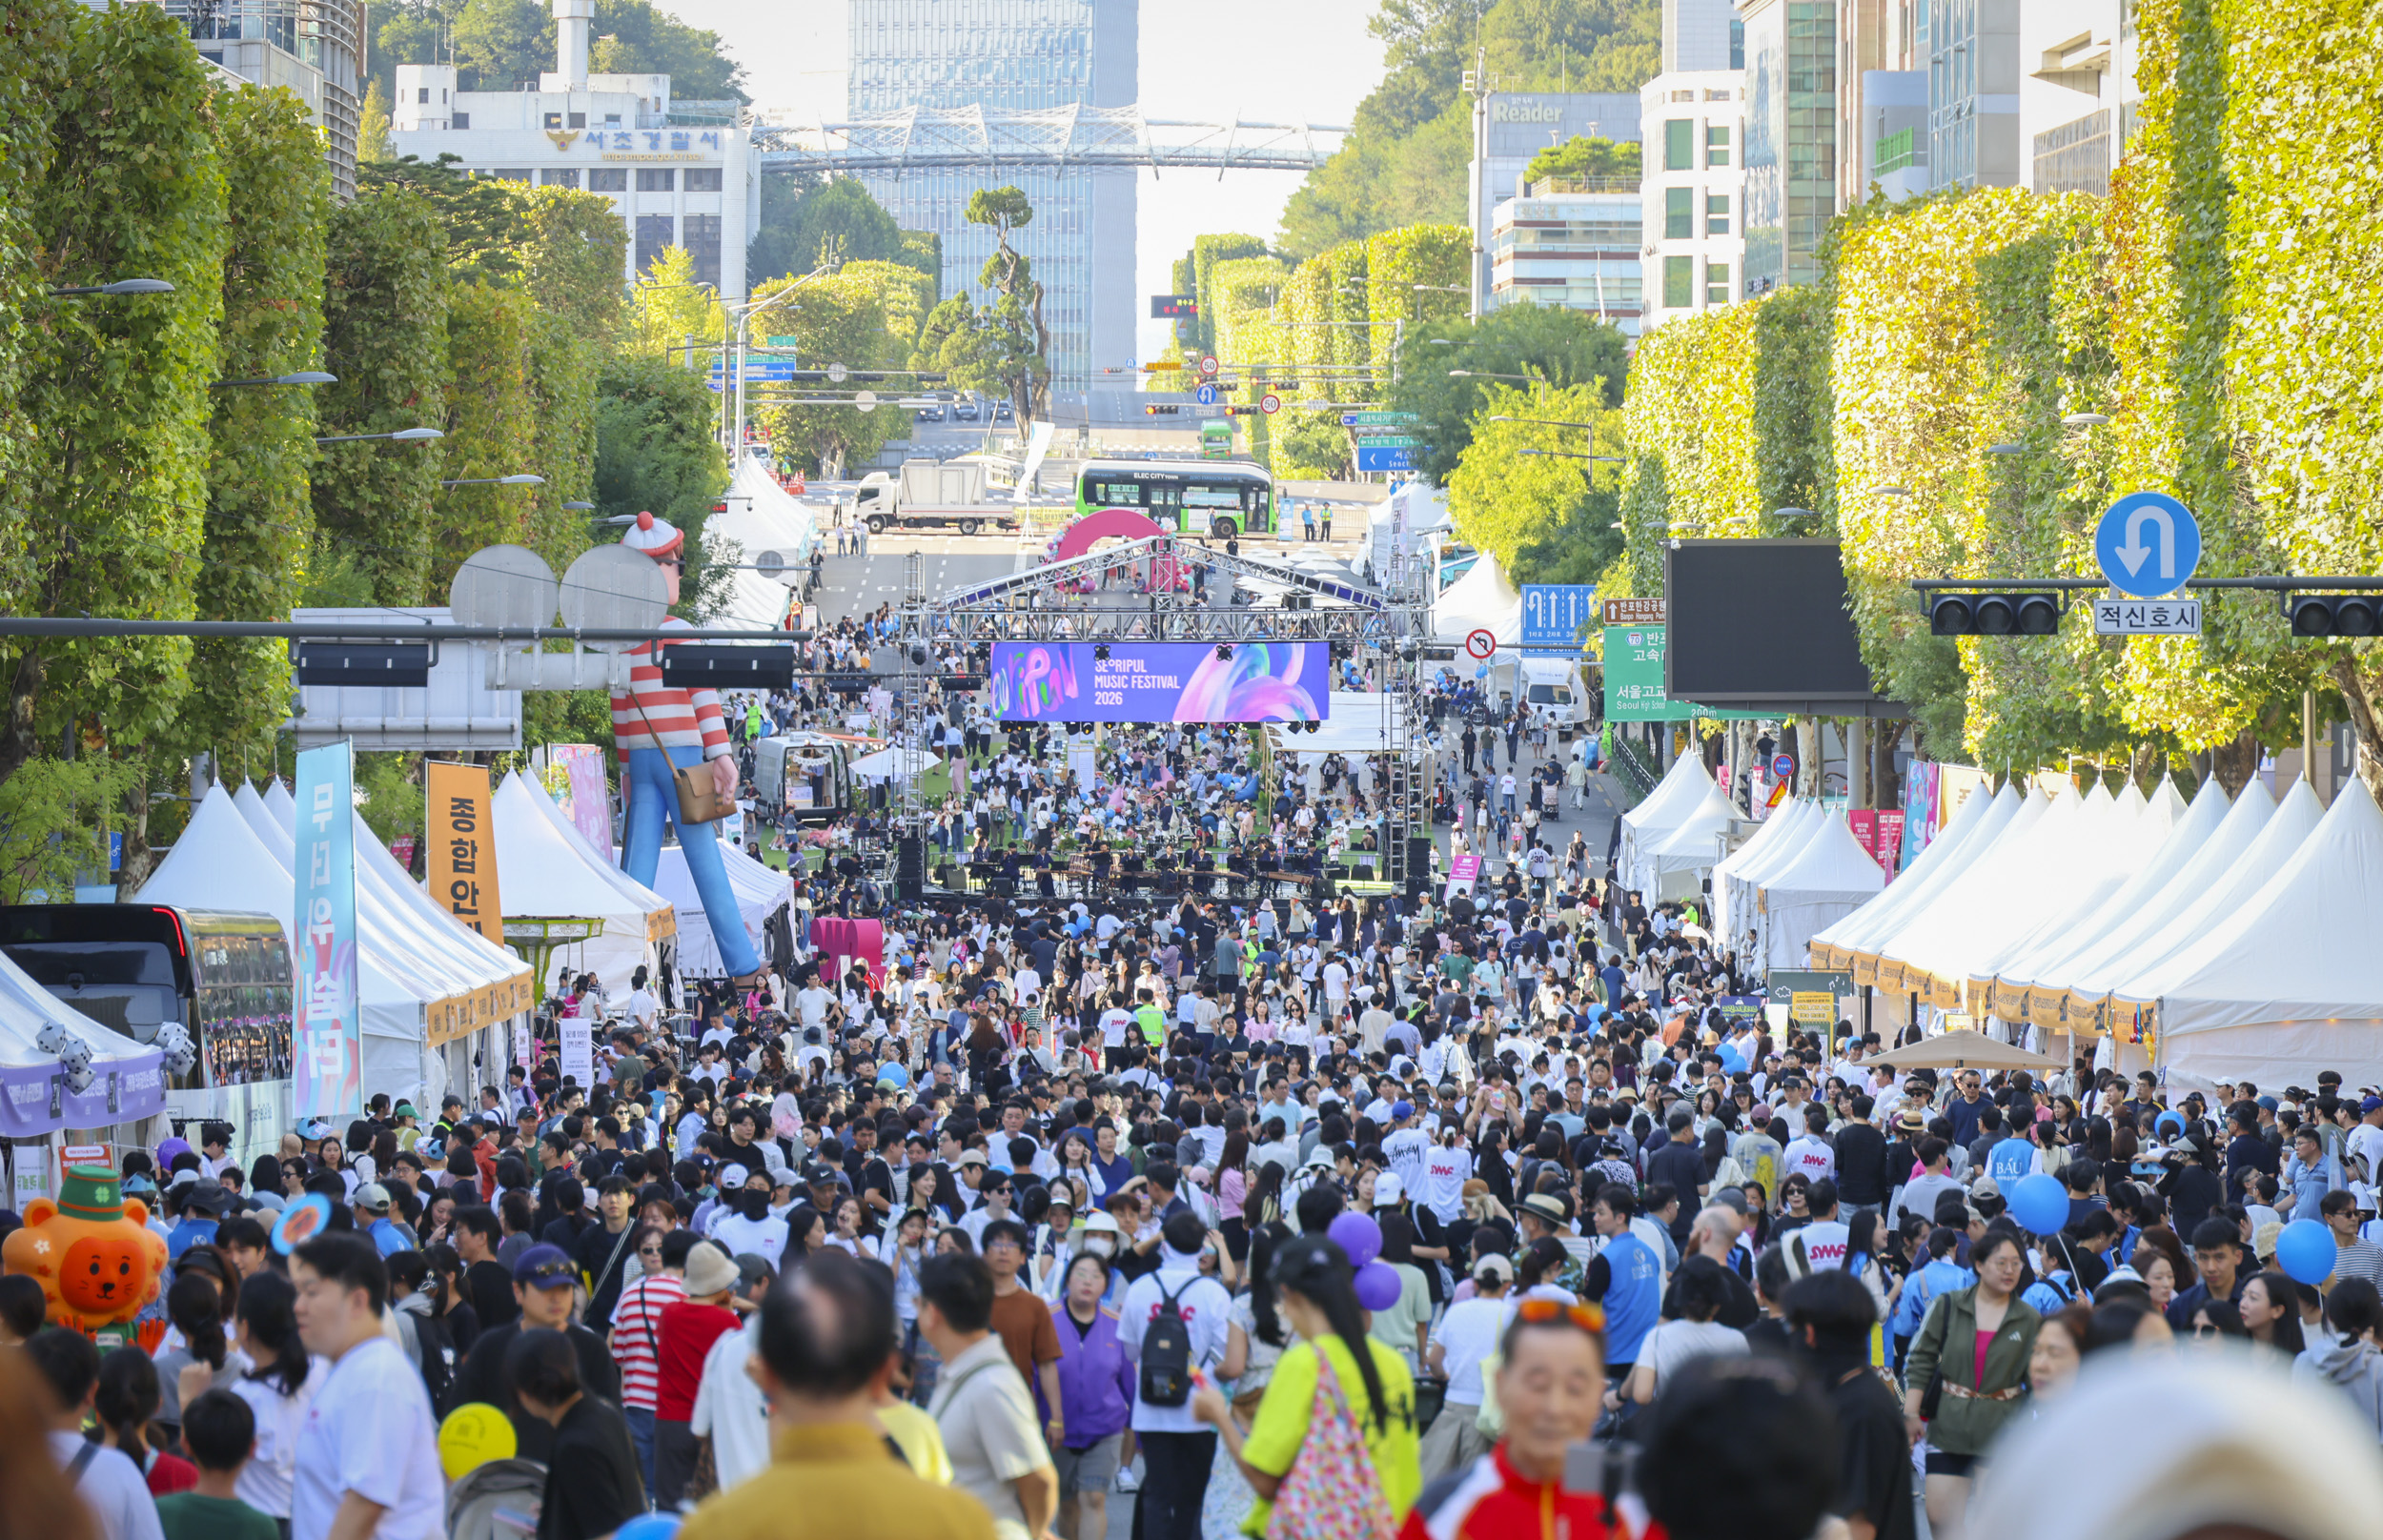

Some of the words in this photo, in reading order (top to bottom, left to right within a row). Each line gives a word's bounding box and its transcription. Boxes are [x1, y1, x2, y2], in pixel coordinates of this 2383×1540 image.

[1494, 100, 1563, 122] Reader
[585, 131, 719, 151] 서초경찰서
[1264, 398, 1276, 409] 50
[1392, 509, 1402, 535] 커피
[1619, 600, 1665, 613] 반포한강공원
[1620, 612, 1634, 620] Banpo
[1635, 612, 1652, 621] Hangang
[2100, 606, 2198, 630] 적신호시
[1630, 637, 1640, 645] 70
[1633, 650, 1665, 661] 고속
[1094, 676, 1128, 689] MUSIC
[1130, 676, 1180, 689] FESTIVAL
[1094, 692, 1123, 705] 2026
[1617, 700, 1640, 710] Seoul
[1640, 700, 1650, 712] High
[1691, 708, 1717, 718] 200m
[450, 797, 482, 936] 종합안
[1148, 1303, 1195, 1323] SF
